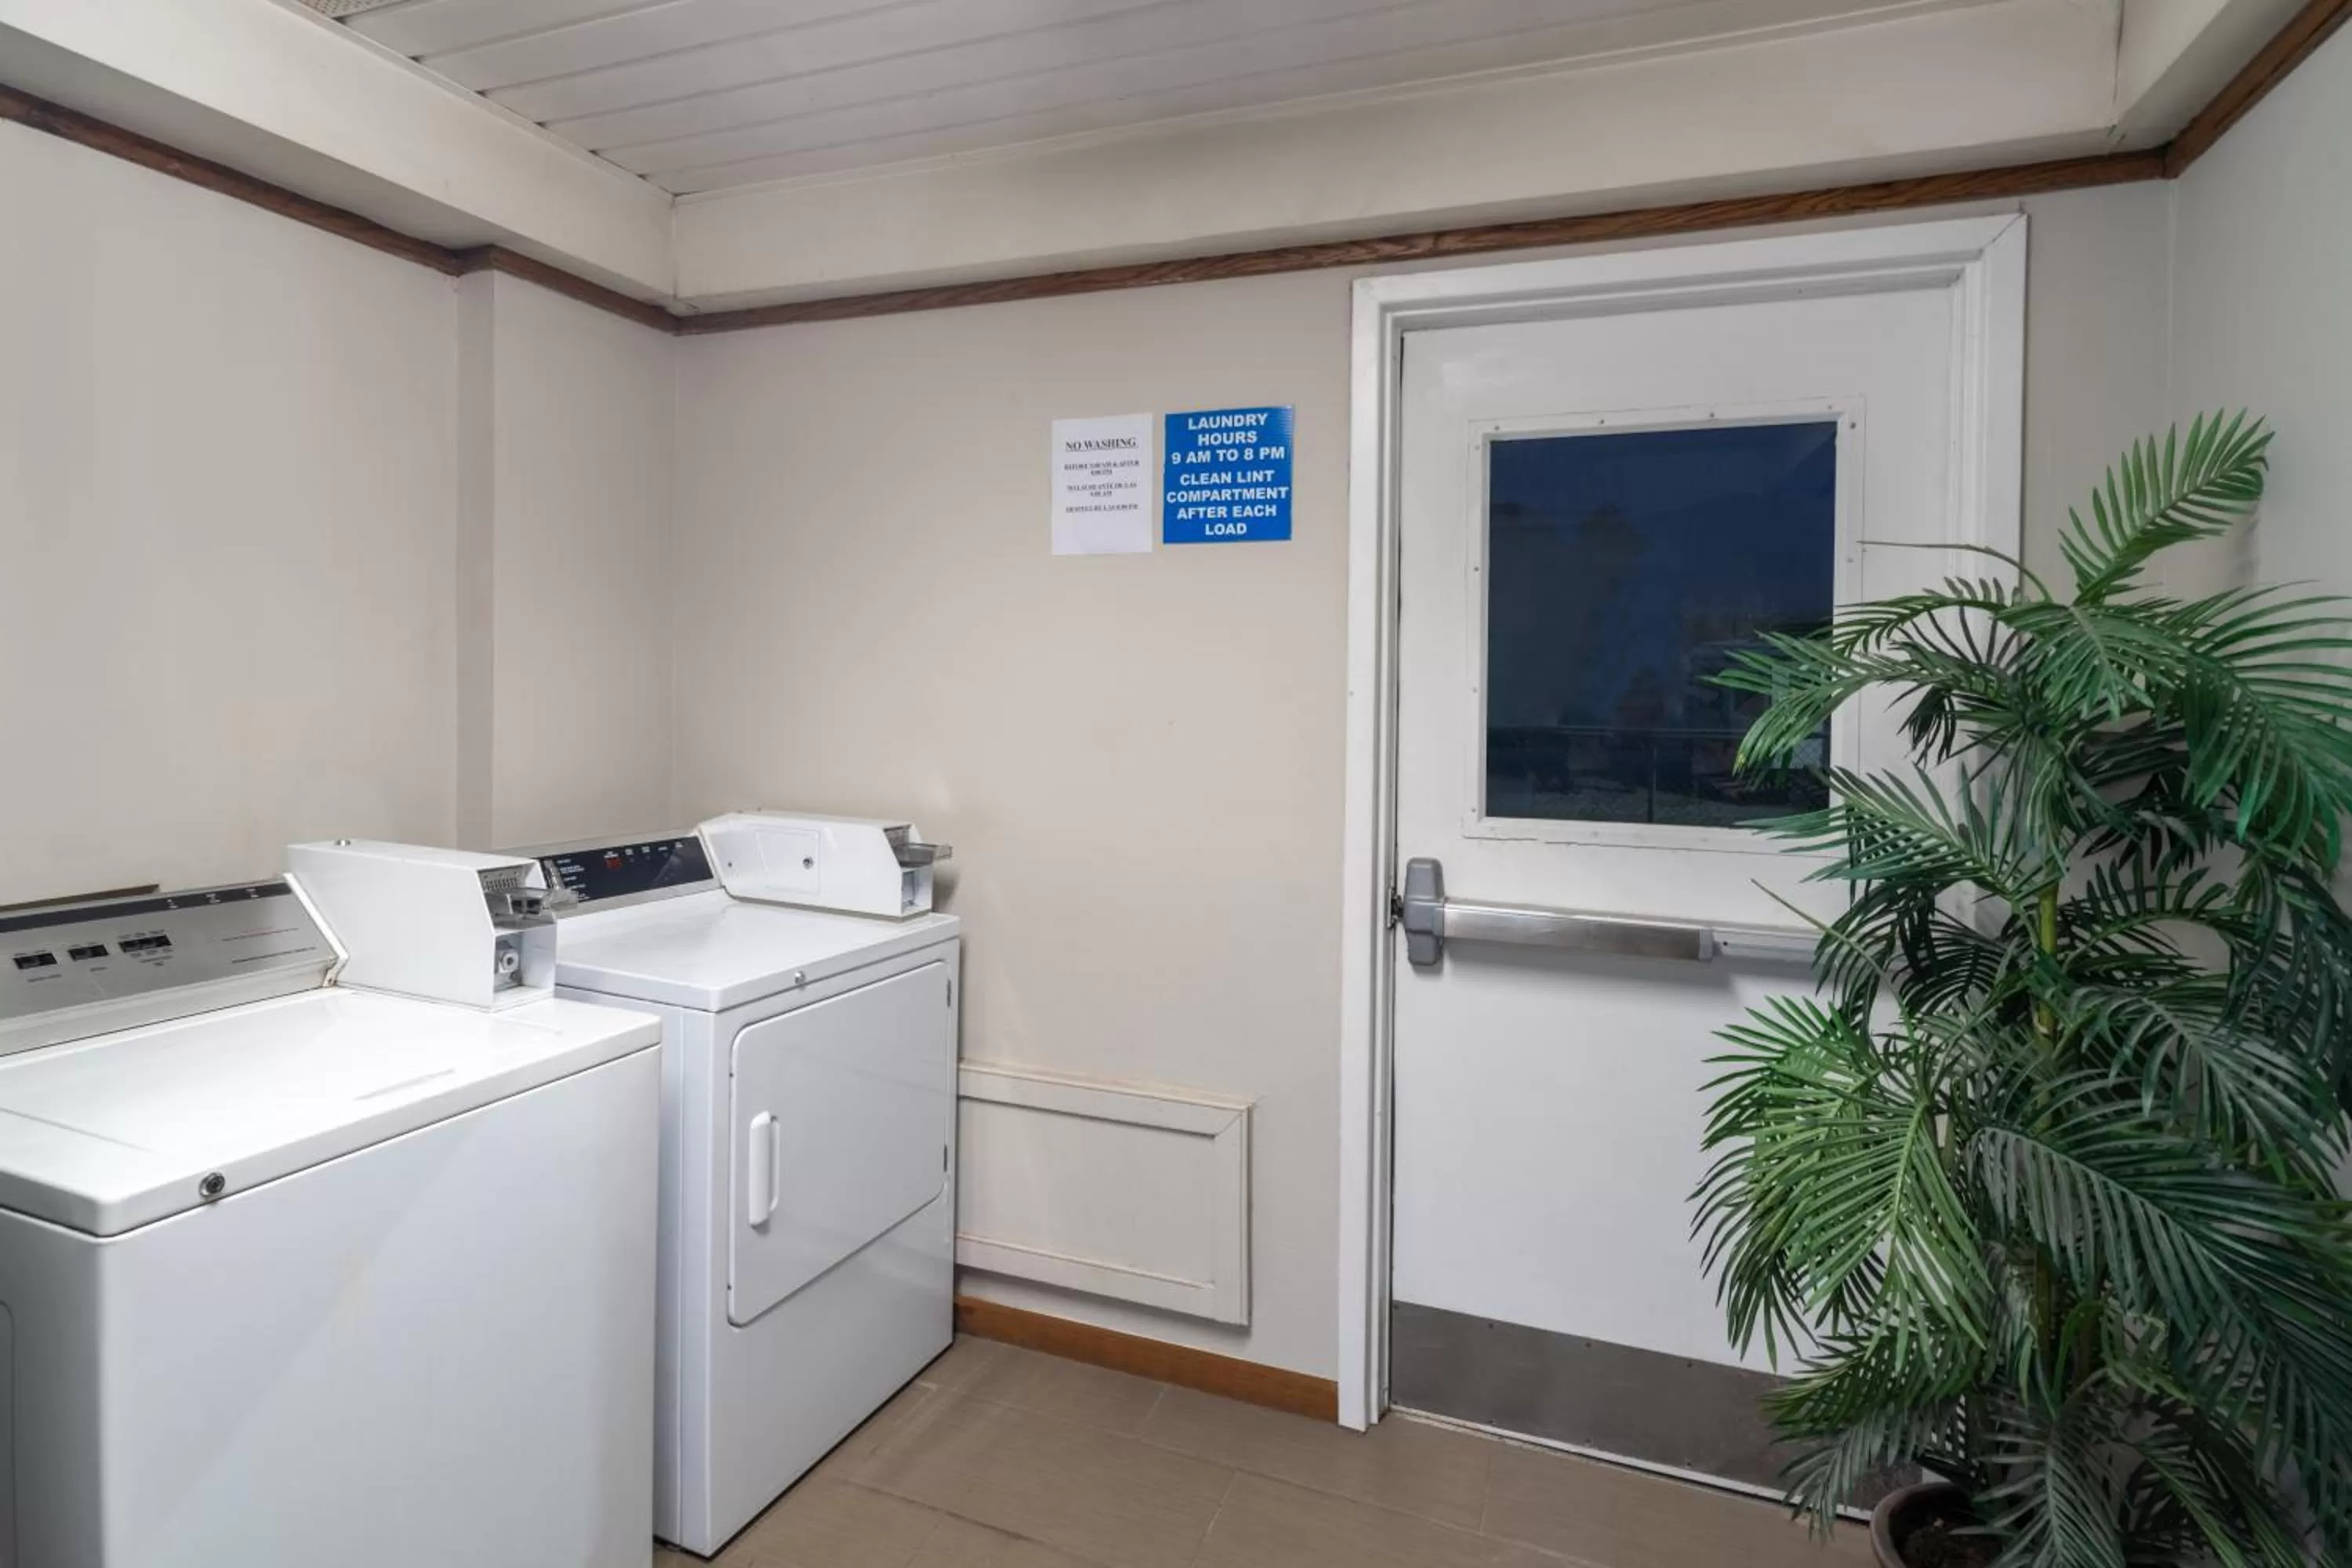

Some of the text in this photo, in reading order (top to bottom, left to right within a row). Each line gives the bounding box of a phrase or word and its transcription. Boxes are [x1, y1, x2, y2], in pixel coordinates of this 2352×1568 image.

[1188, 413, 1269, 430] LAUNDRY
[1065, 437, 1136, 451] NO WASHING
[1197, 430, 1258, 446] HOURS
[1171, 446, 1285, 465] 9 AM TO 8 PM
[1180, 470, 1275, 486] CLEAN LINT
[1167, 486, 1289, 503] COMPARTMENT
[1177, 504, 1277, 520] AFTER EACH
[1204, 523, 1247, 535] LOAD
